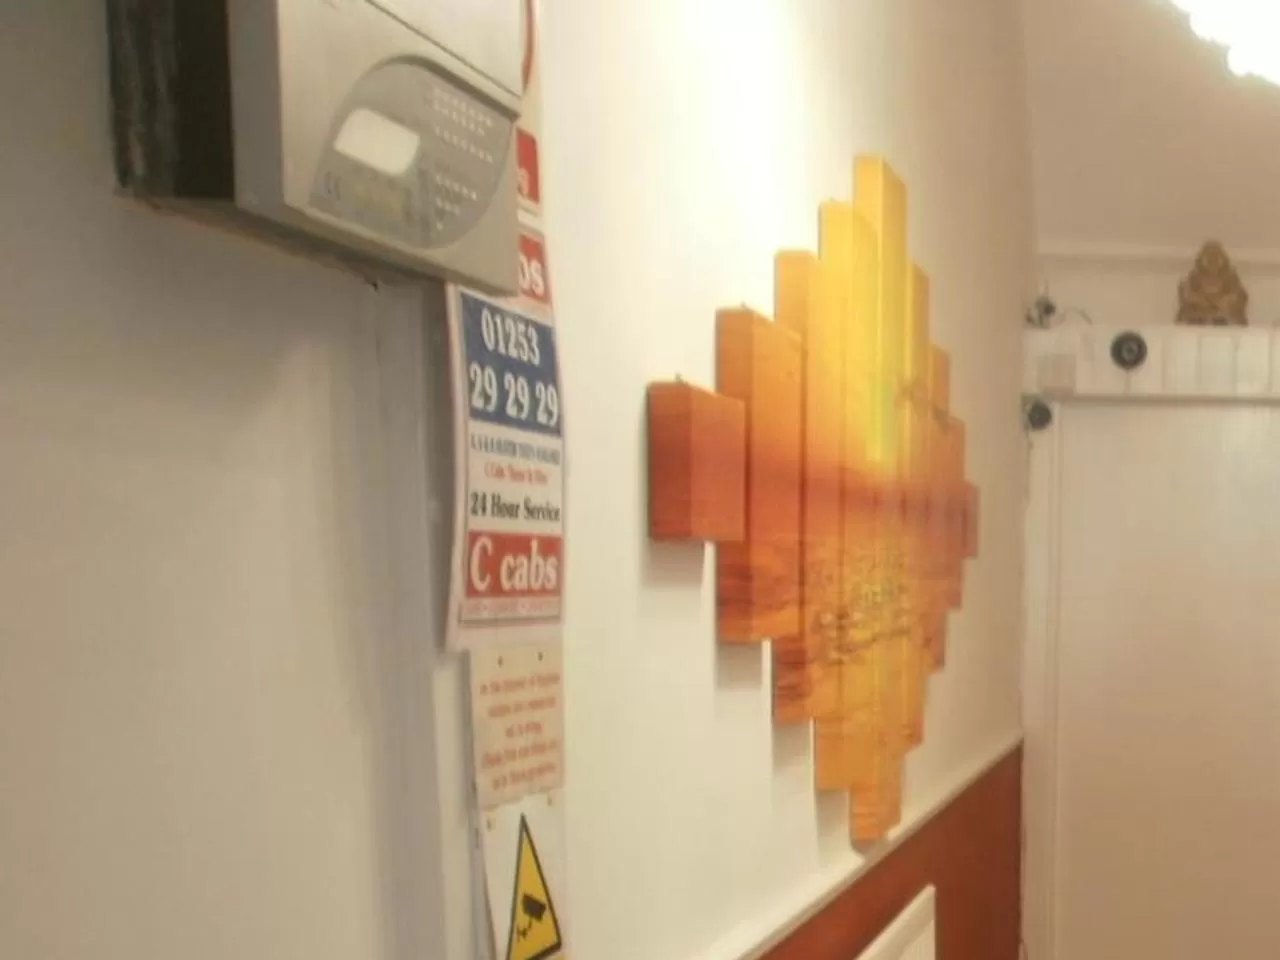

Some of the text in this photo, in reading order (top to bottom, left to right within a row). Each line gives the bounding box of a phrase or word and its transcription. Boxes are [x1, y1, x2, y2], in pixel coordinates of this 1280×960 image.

[481, 306, 541, 367] 01253
[469, 360, 559, 428] 29 29 29
[470, 491, 561, 523] 24 Hour Service
[470, 535, 559, 593] C cabs
